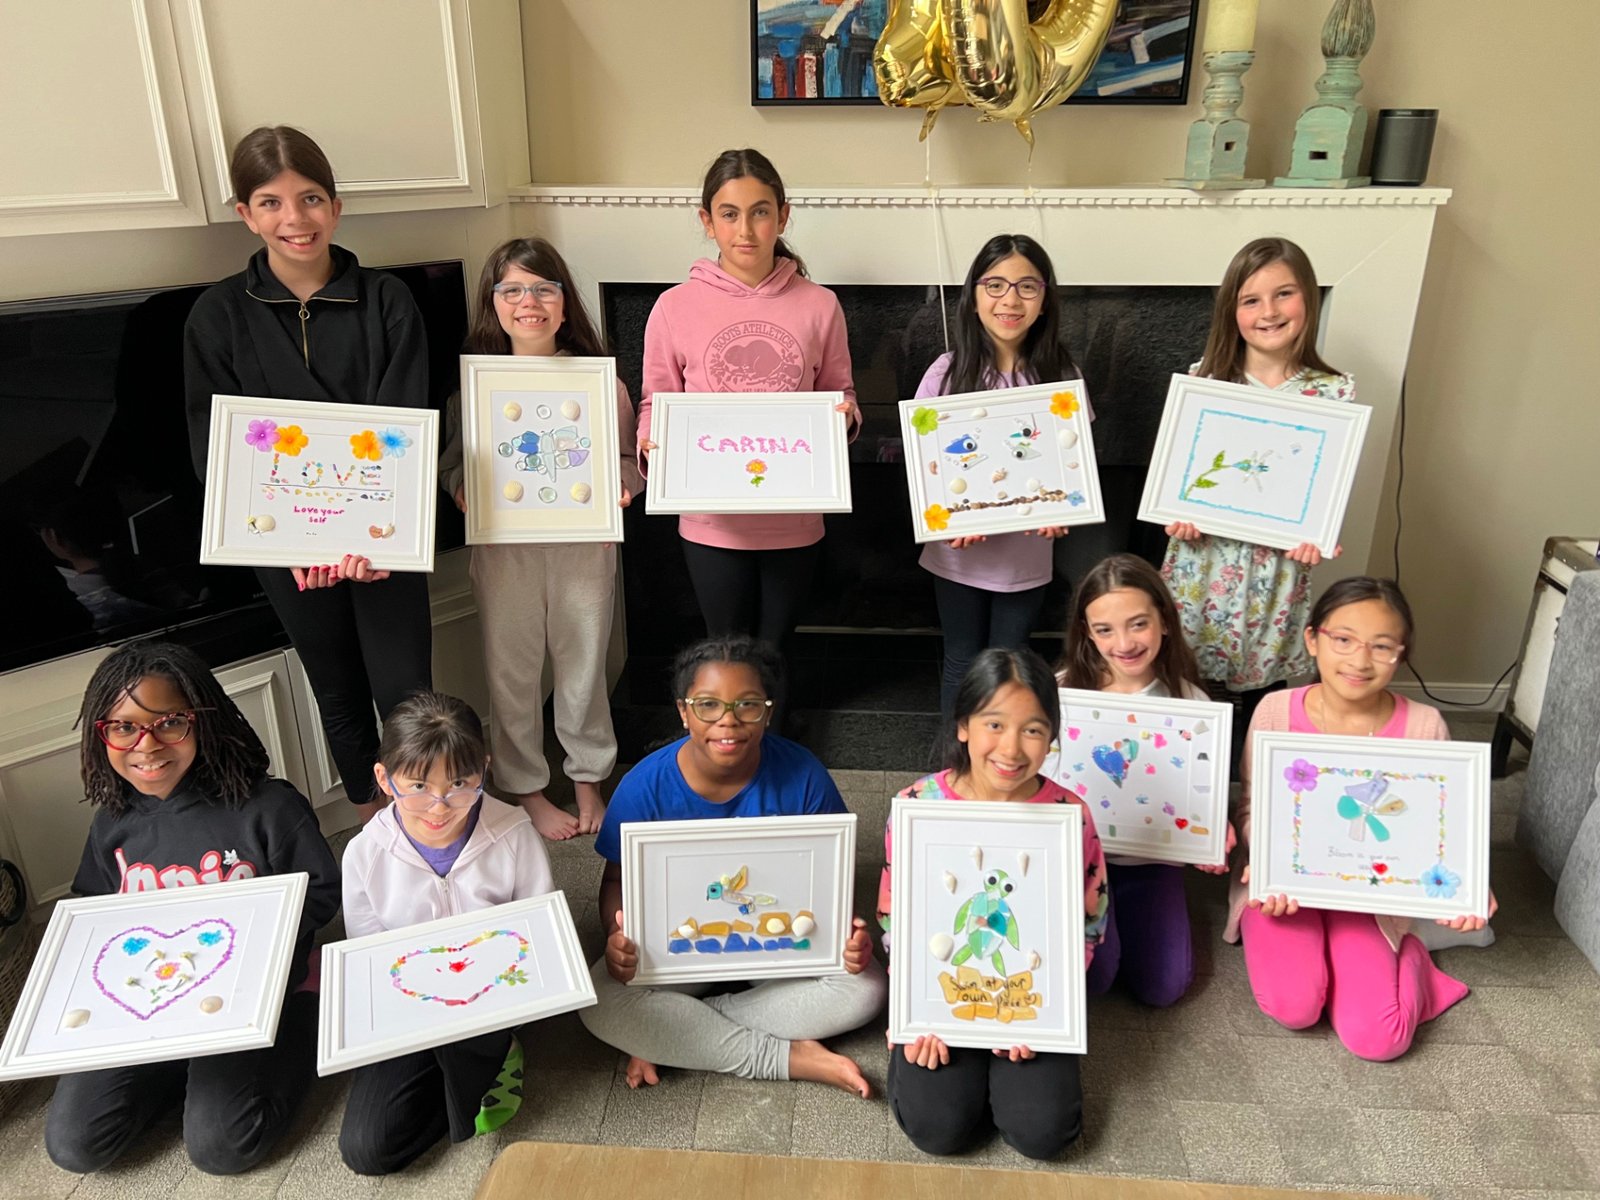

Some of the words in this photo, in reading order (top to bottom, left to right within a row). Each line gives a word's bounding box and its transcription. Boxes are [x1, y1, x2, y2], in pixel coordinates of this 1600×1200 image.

[712, 326, 741, 351] ROOTS
[743, 323, 795, 349] ATHLETICS
[697, 434, 812, 454] CARINA
[270, 453, 382, 488] LOVE
[294, 505, 318, 513] Love
[320, 508, 345, 516] your
[985, 976, 997, 987] at
[1003, 978, 1026, 998] your
[962, 993, 987, 1003] own
